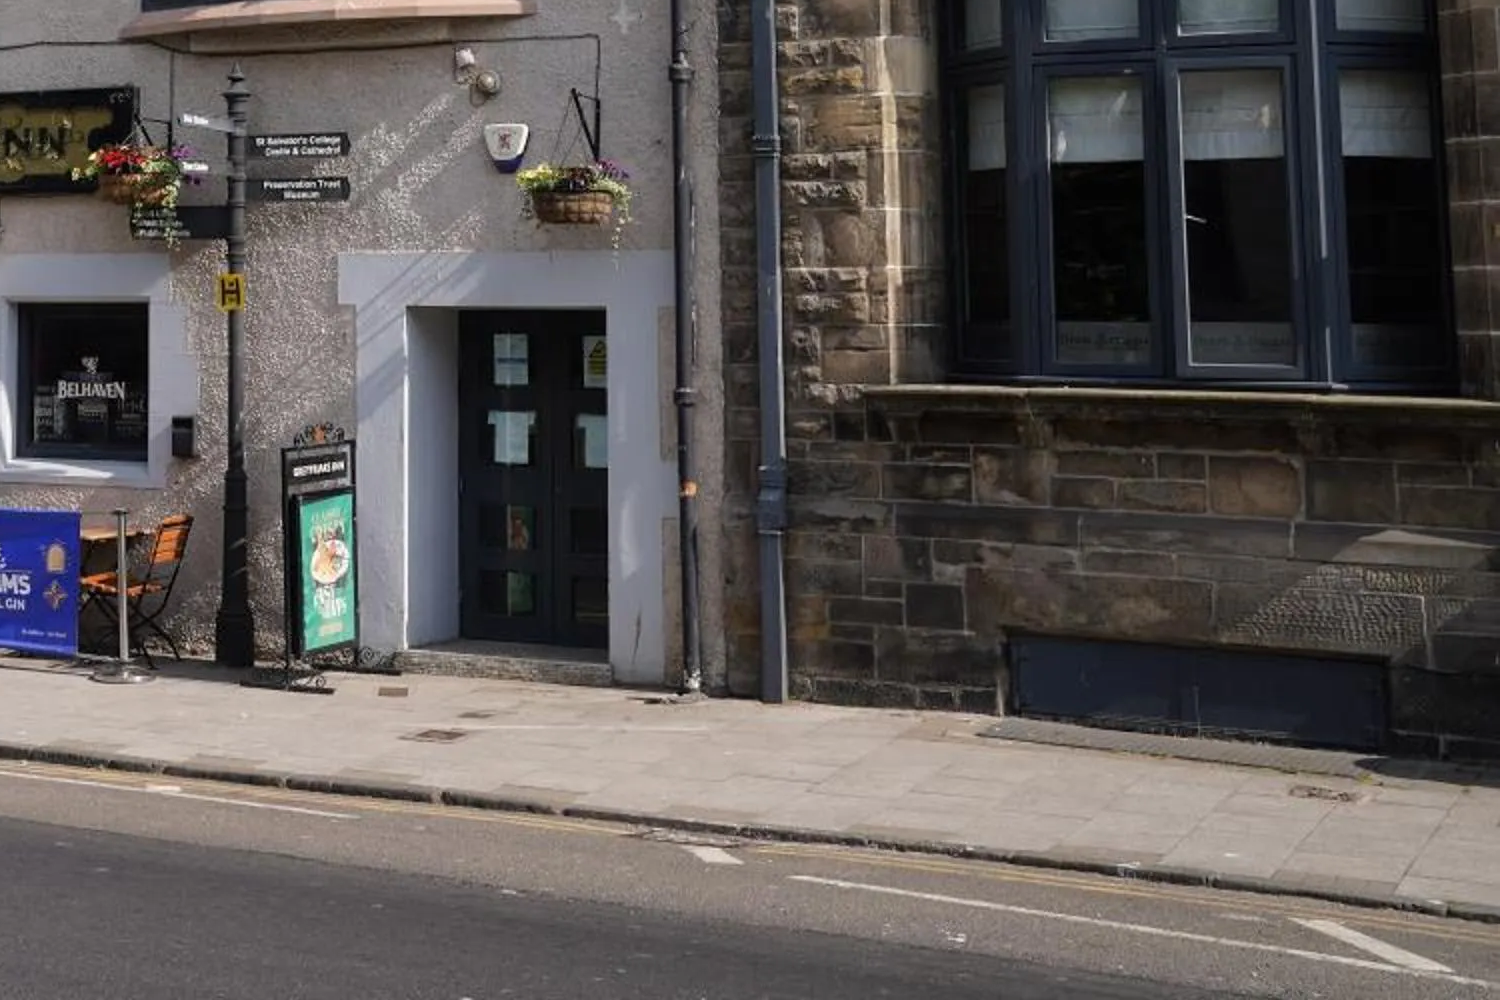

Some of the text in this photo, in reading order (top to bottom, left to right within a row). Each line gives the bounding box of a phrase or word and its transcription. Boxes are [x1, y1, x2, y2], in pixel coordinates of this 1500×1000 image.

[221, 277, 241, 308] H
[58, 379, 126, 401] BELHAVEN
[5, 599, 25, 611] GIN
